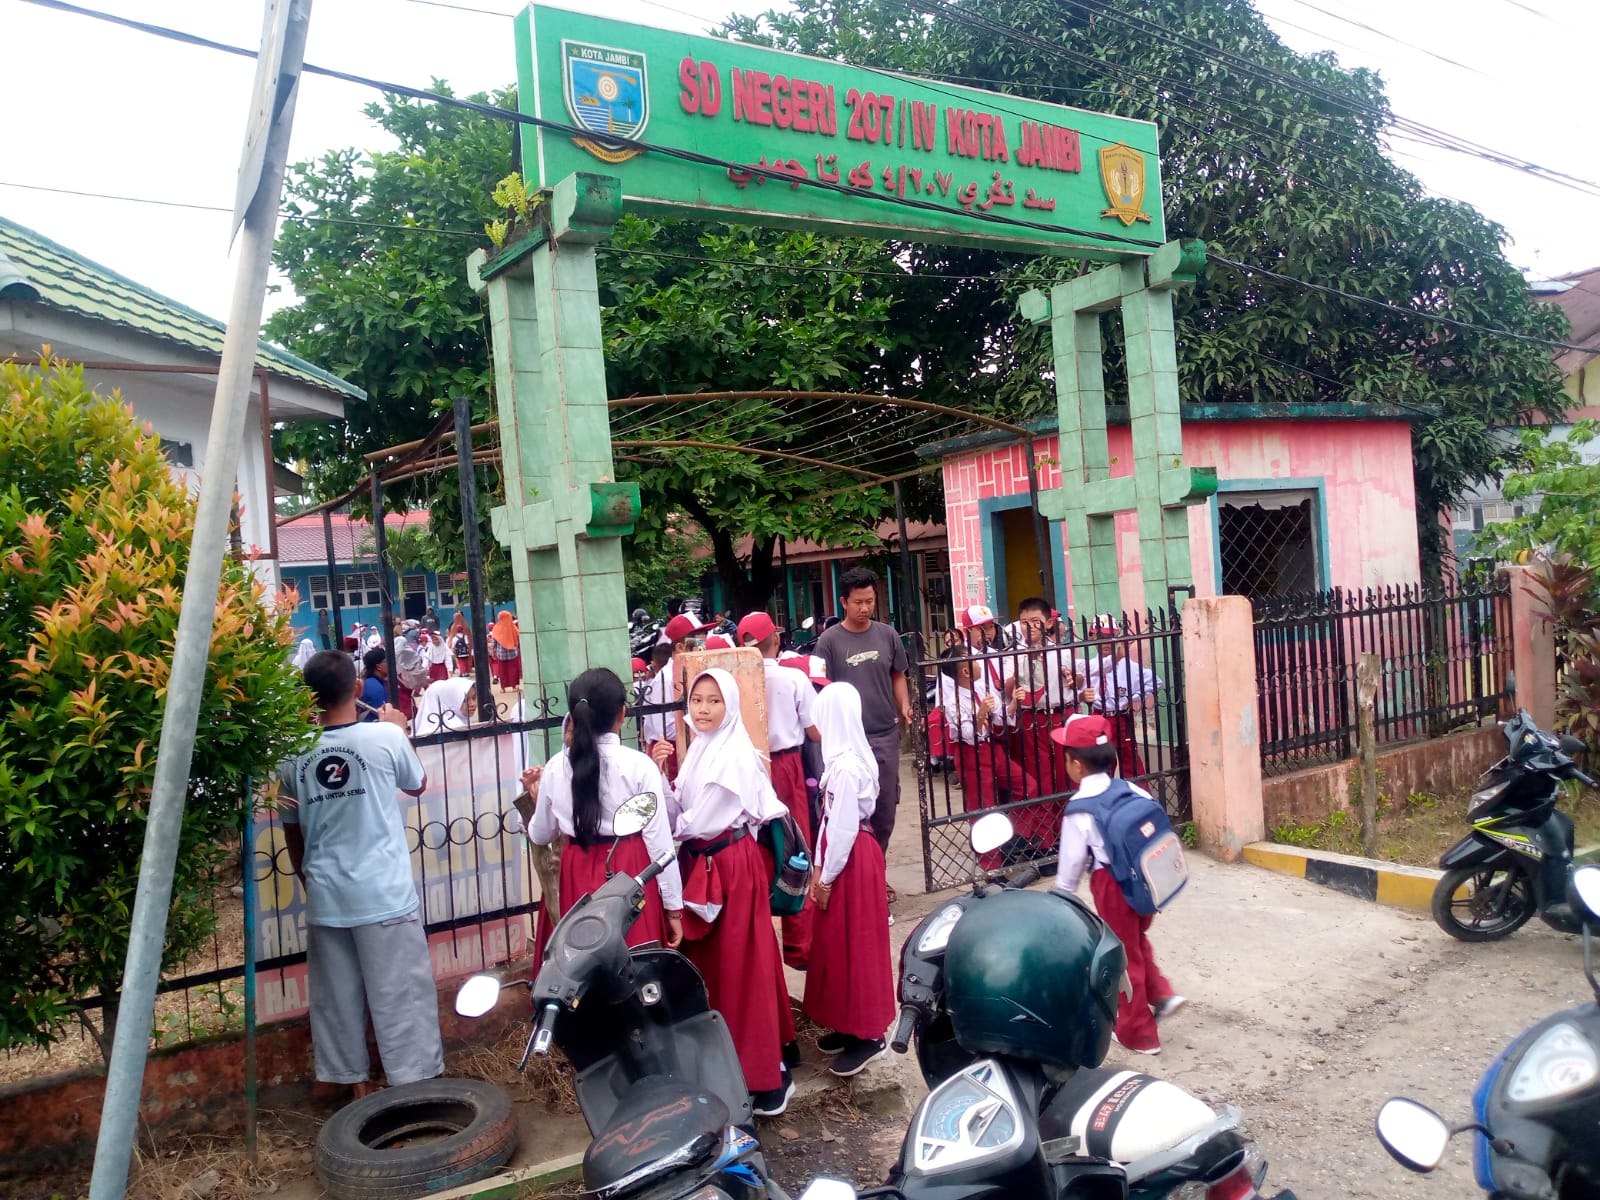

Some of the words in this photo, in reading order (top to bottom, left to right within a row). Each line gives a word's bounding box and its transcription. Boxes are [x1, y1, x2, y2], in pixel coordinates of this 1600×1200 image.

[581, 48, 603, 61] KOTA
[605, 52, 630, 66] JAMBI
[679, 57, 722, 116] SD
[731, 67, 838, 136] NEGERI
[946, 106, 1009, 163] KOTA
[1017, 119, 1082, 174] JAMBI
[322, 747, 354, 757] ABDULLAH
[354, 754, 366, 771] SANI
[325, 790, 346, 800] UNTUK
